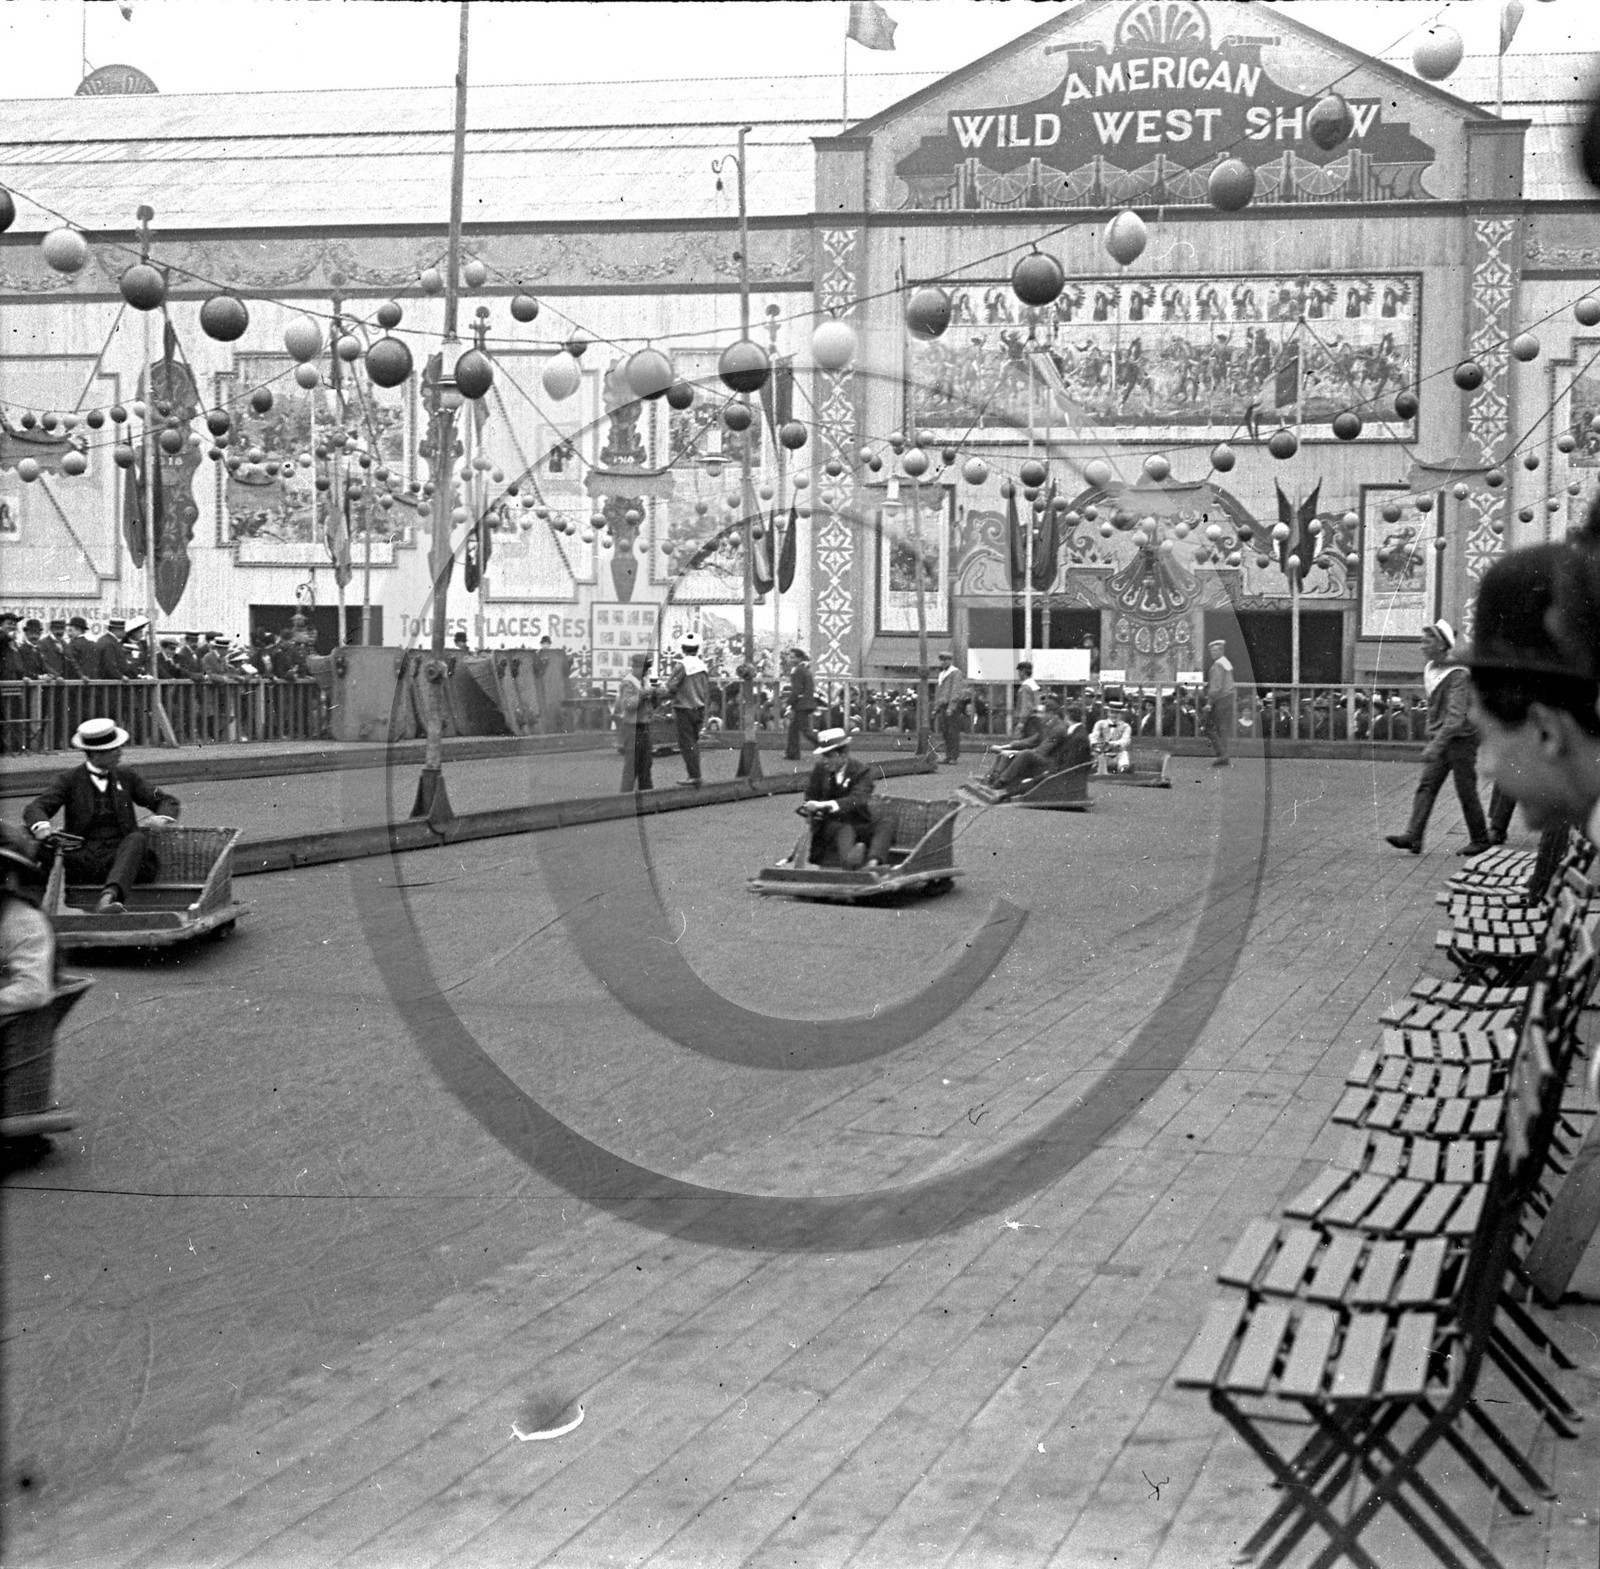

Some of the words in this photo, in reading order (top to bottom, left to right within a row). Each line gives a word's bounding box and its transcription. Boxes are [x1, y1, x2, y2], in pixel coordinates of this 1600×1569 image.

[1062, 56, 1261, 106] AMERICAN
[952, 113, 1061, 149] WILD
[1092, 108, 1222, 145] WEST
[1245, 103, 1380, 141] SHW
[400, 613, 468, 637] TOUES
